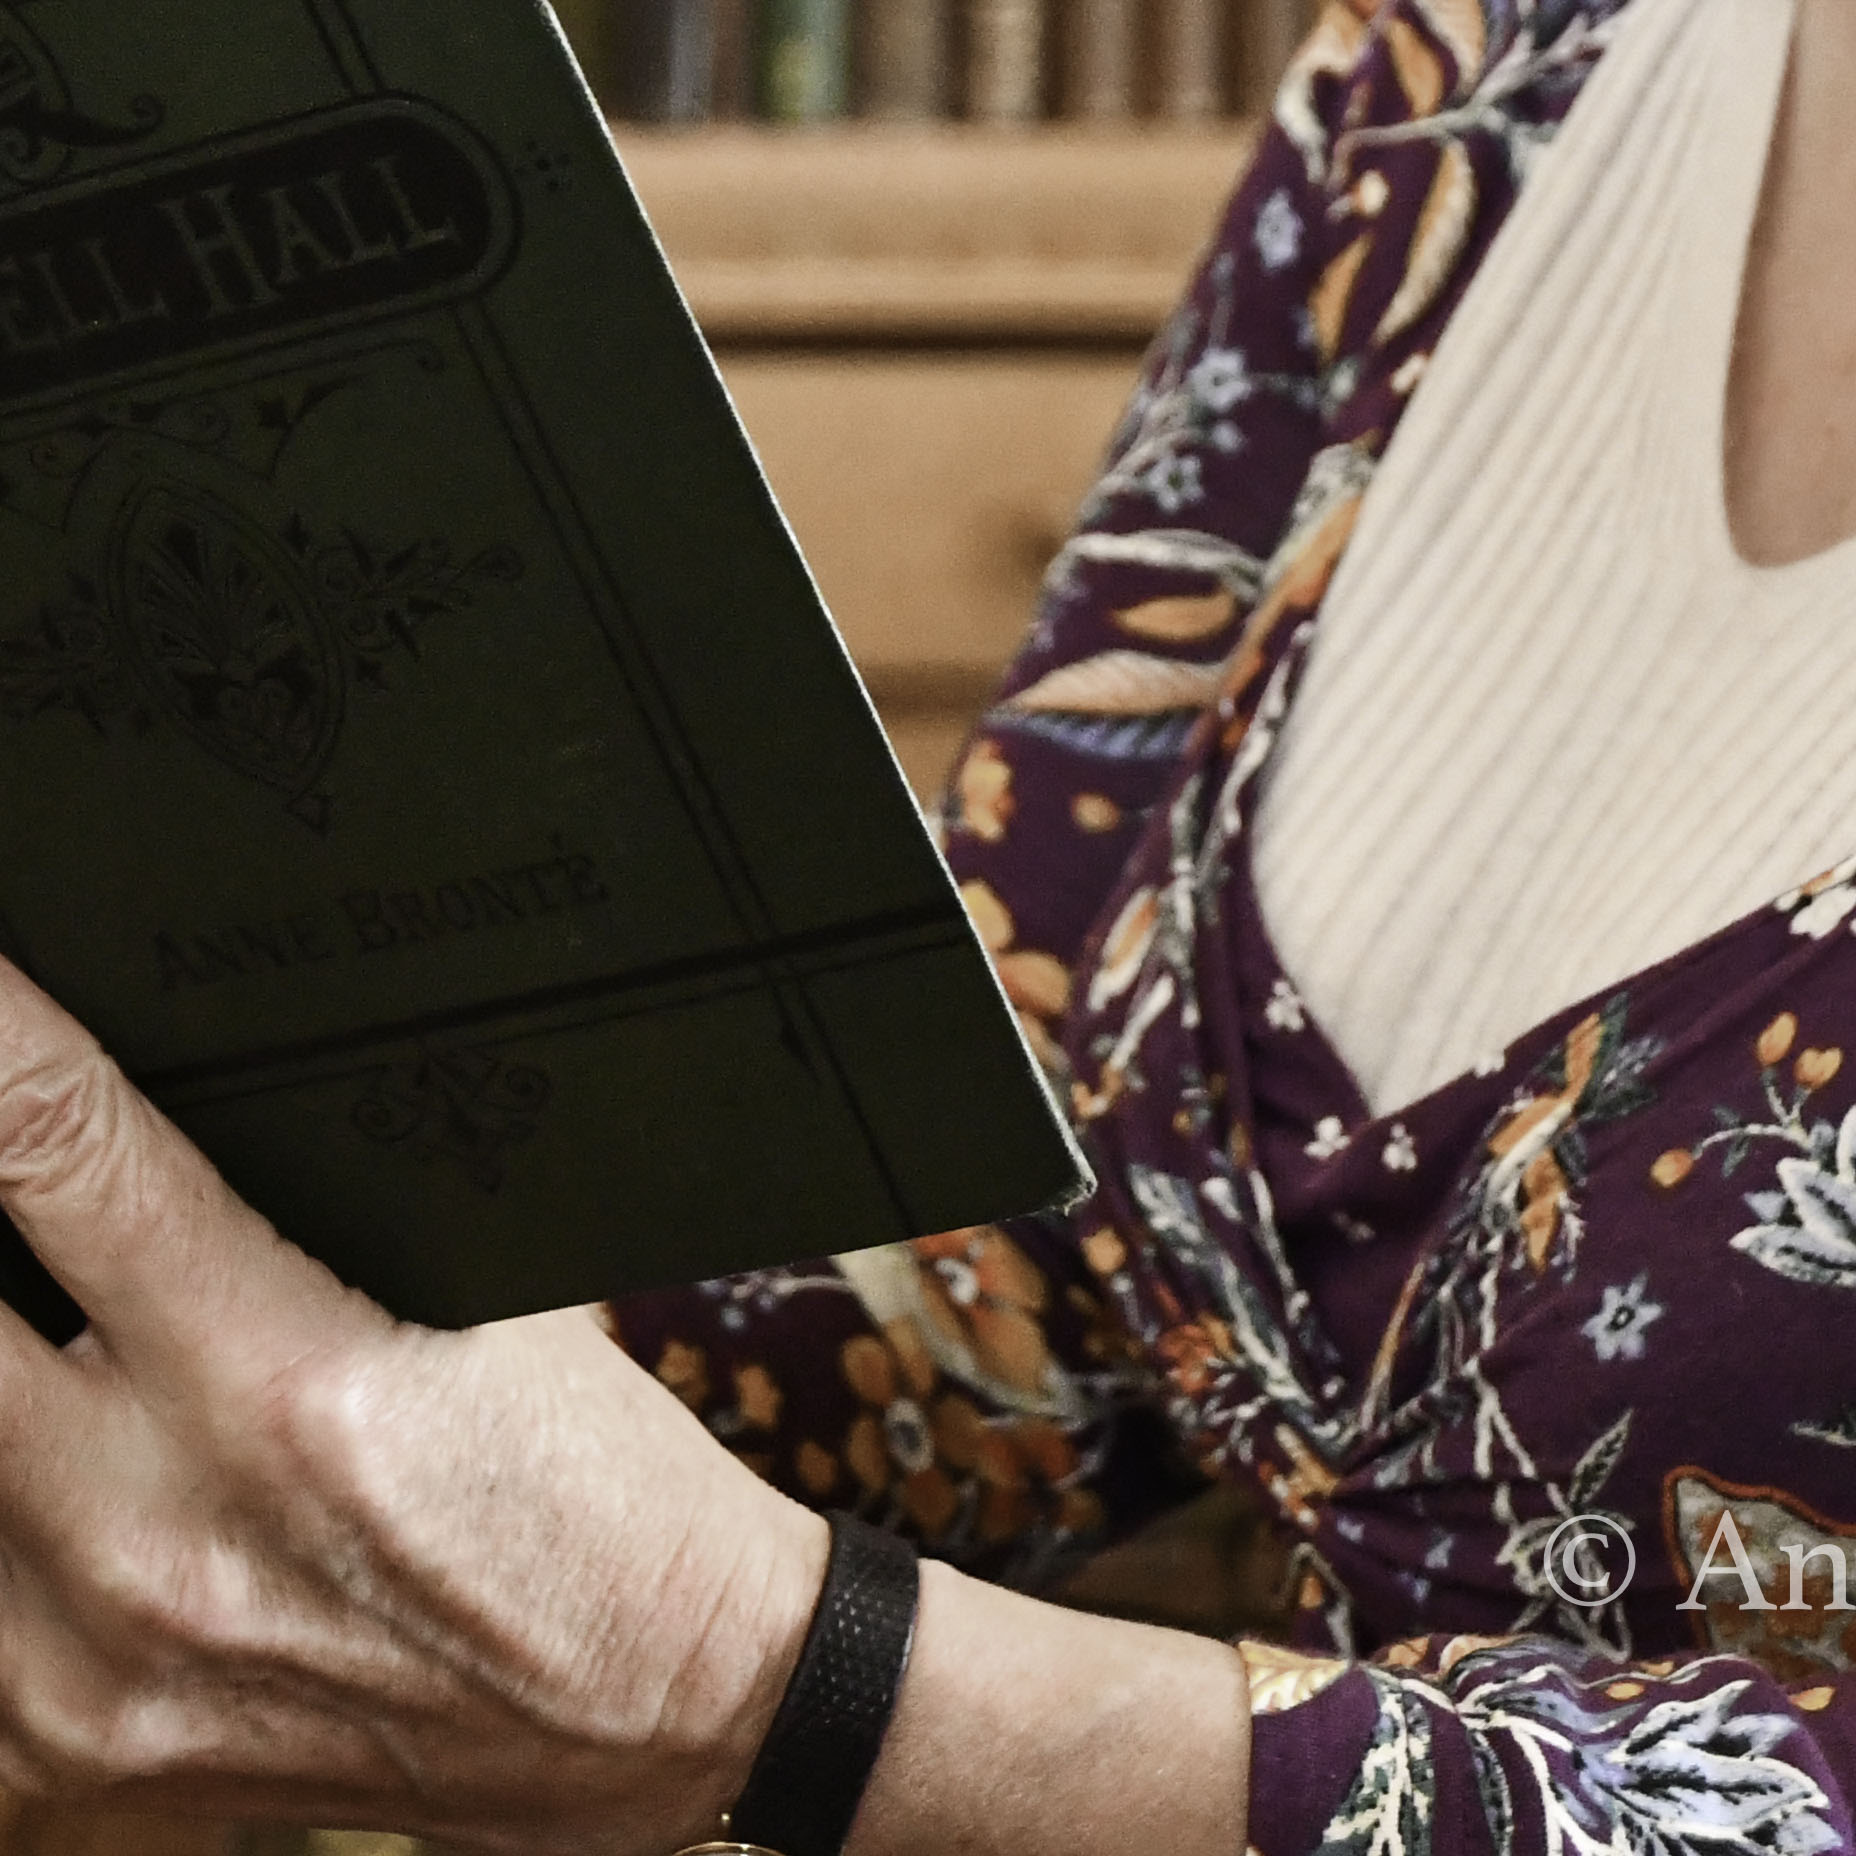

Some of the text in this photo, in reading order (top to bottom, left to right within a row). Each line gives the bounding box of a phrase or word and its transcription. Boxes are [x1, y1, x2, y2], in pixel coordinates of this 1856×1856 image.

[155, 156, 457, 314] HALL
[153, 831, 610, 993] ANNE BRONTÉ
